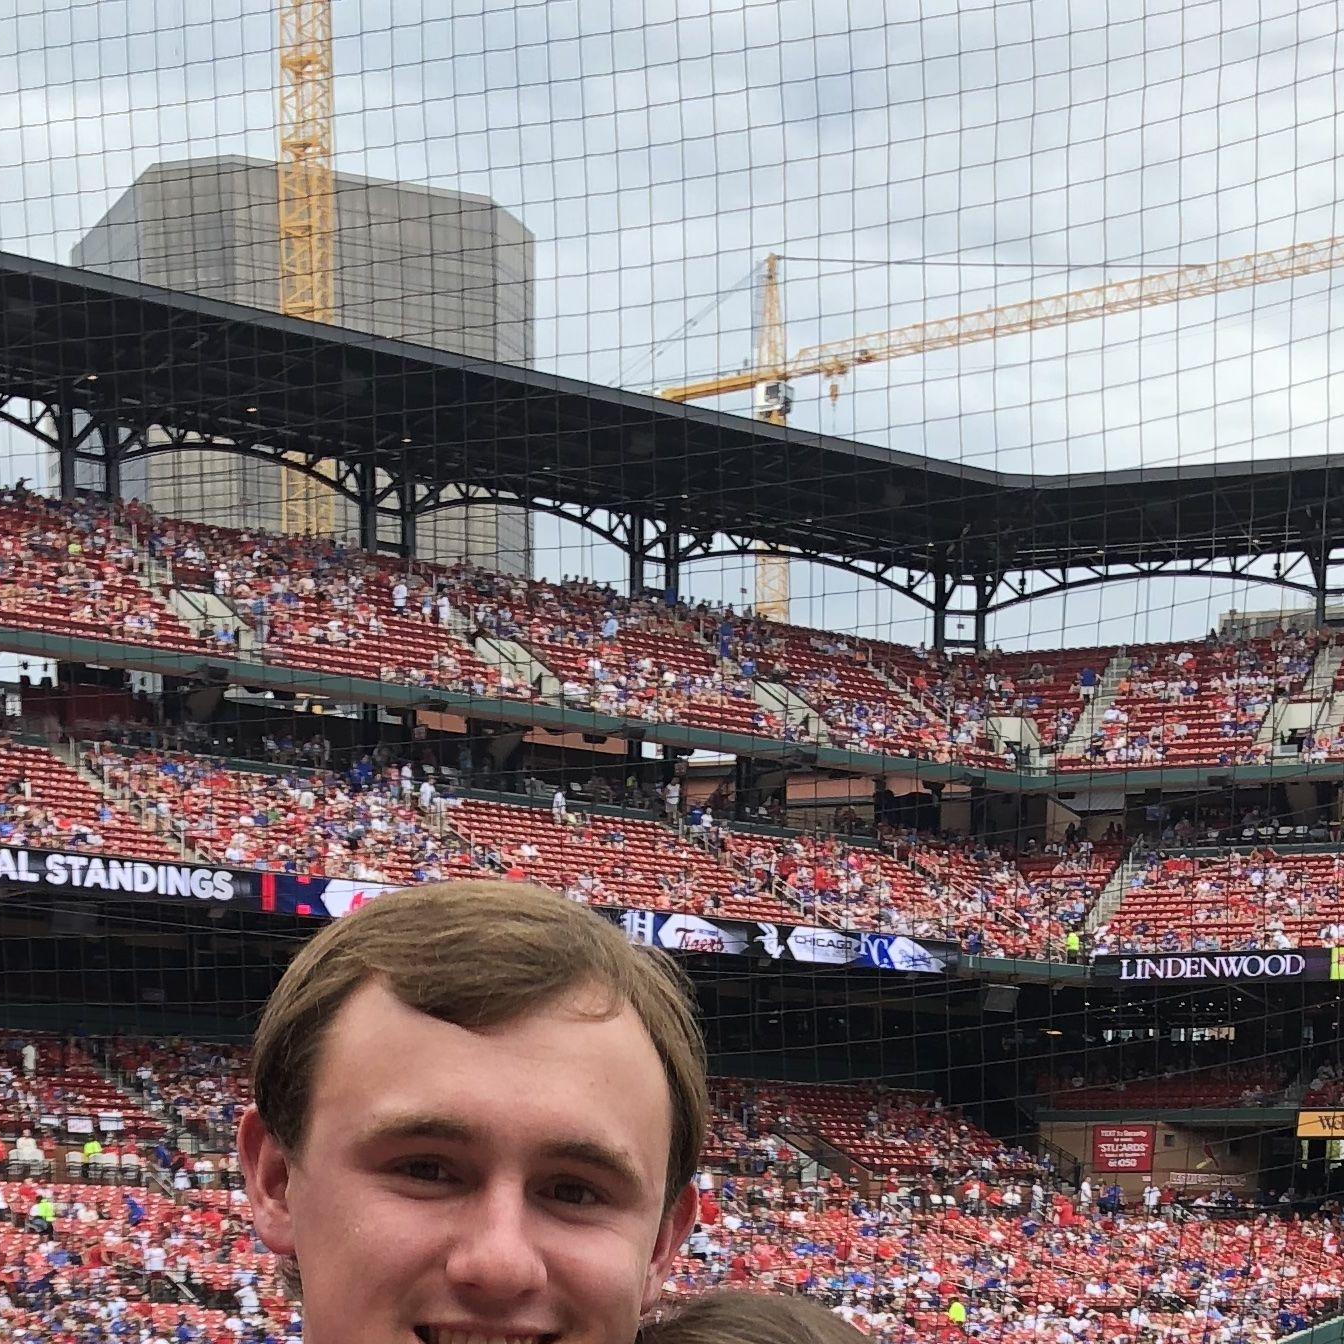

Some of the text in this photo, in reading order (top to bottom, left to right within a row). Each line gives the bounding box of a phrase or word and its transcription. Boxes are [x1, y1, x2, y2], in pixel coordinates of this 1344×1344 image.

[45, 853, 234, 901] STANDINGS
[794, 935, 852, 950] CHICAGO
[1119, 954, 1305, 980] LINDENWOOD
